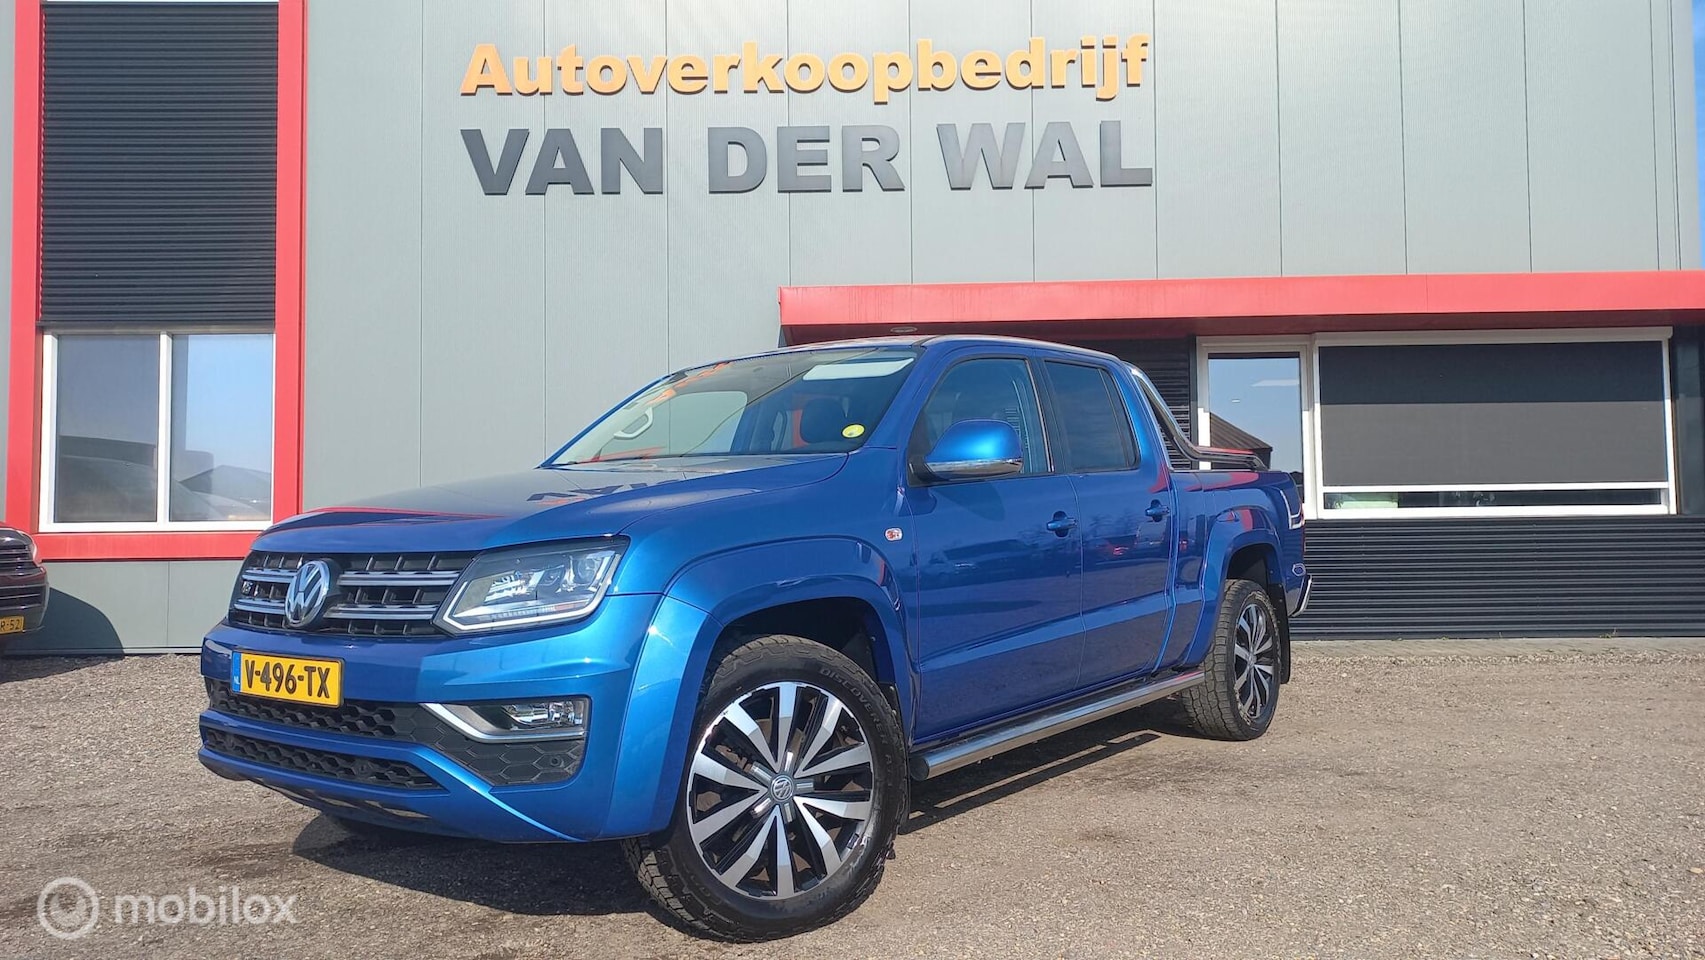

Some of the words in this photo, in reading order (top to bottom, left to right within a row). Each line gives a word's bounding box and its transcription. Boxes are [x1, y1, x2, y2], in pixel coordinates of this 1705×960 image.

[461, 34, 1149, 105] Autoverkoopbedrijf
[460, 127, 664, 196] VAN
[708, 124, 906, 194] DER
[936, 120, 1153, 191] WAL
[244, 659, 331, 699] V-496-TX
